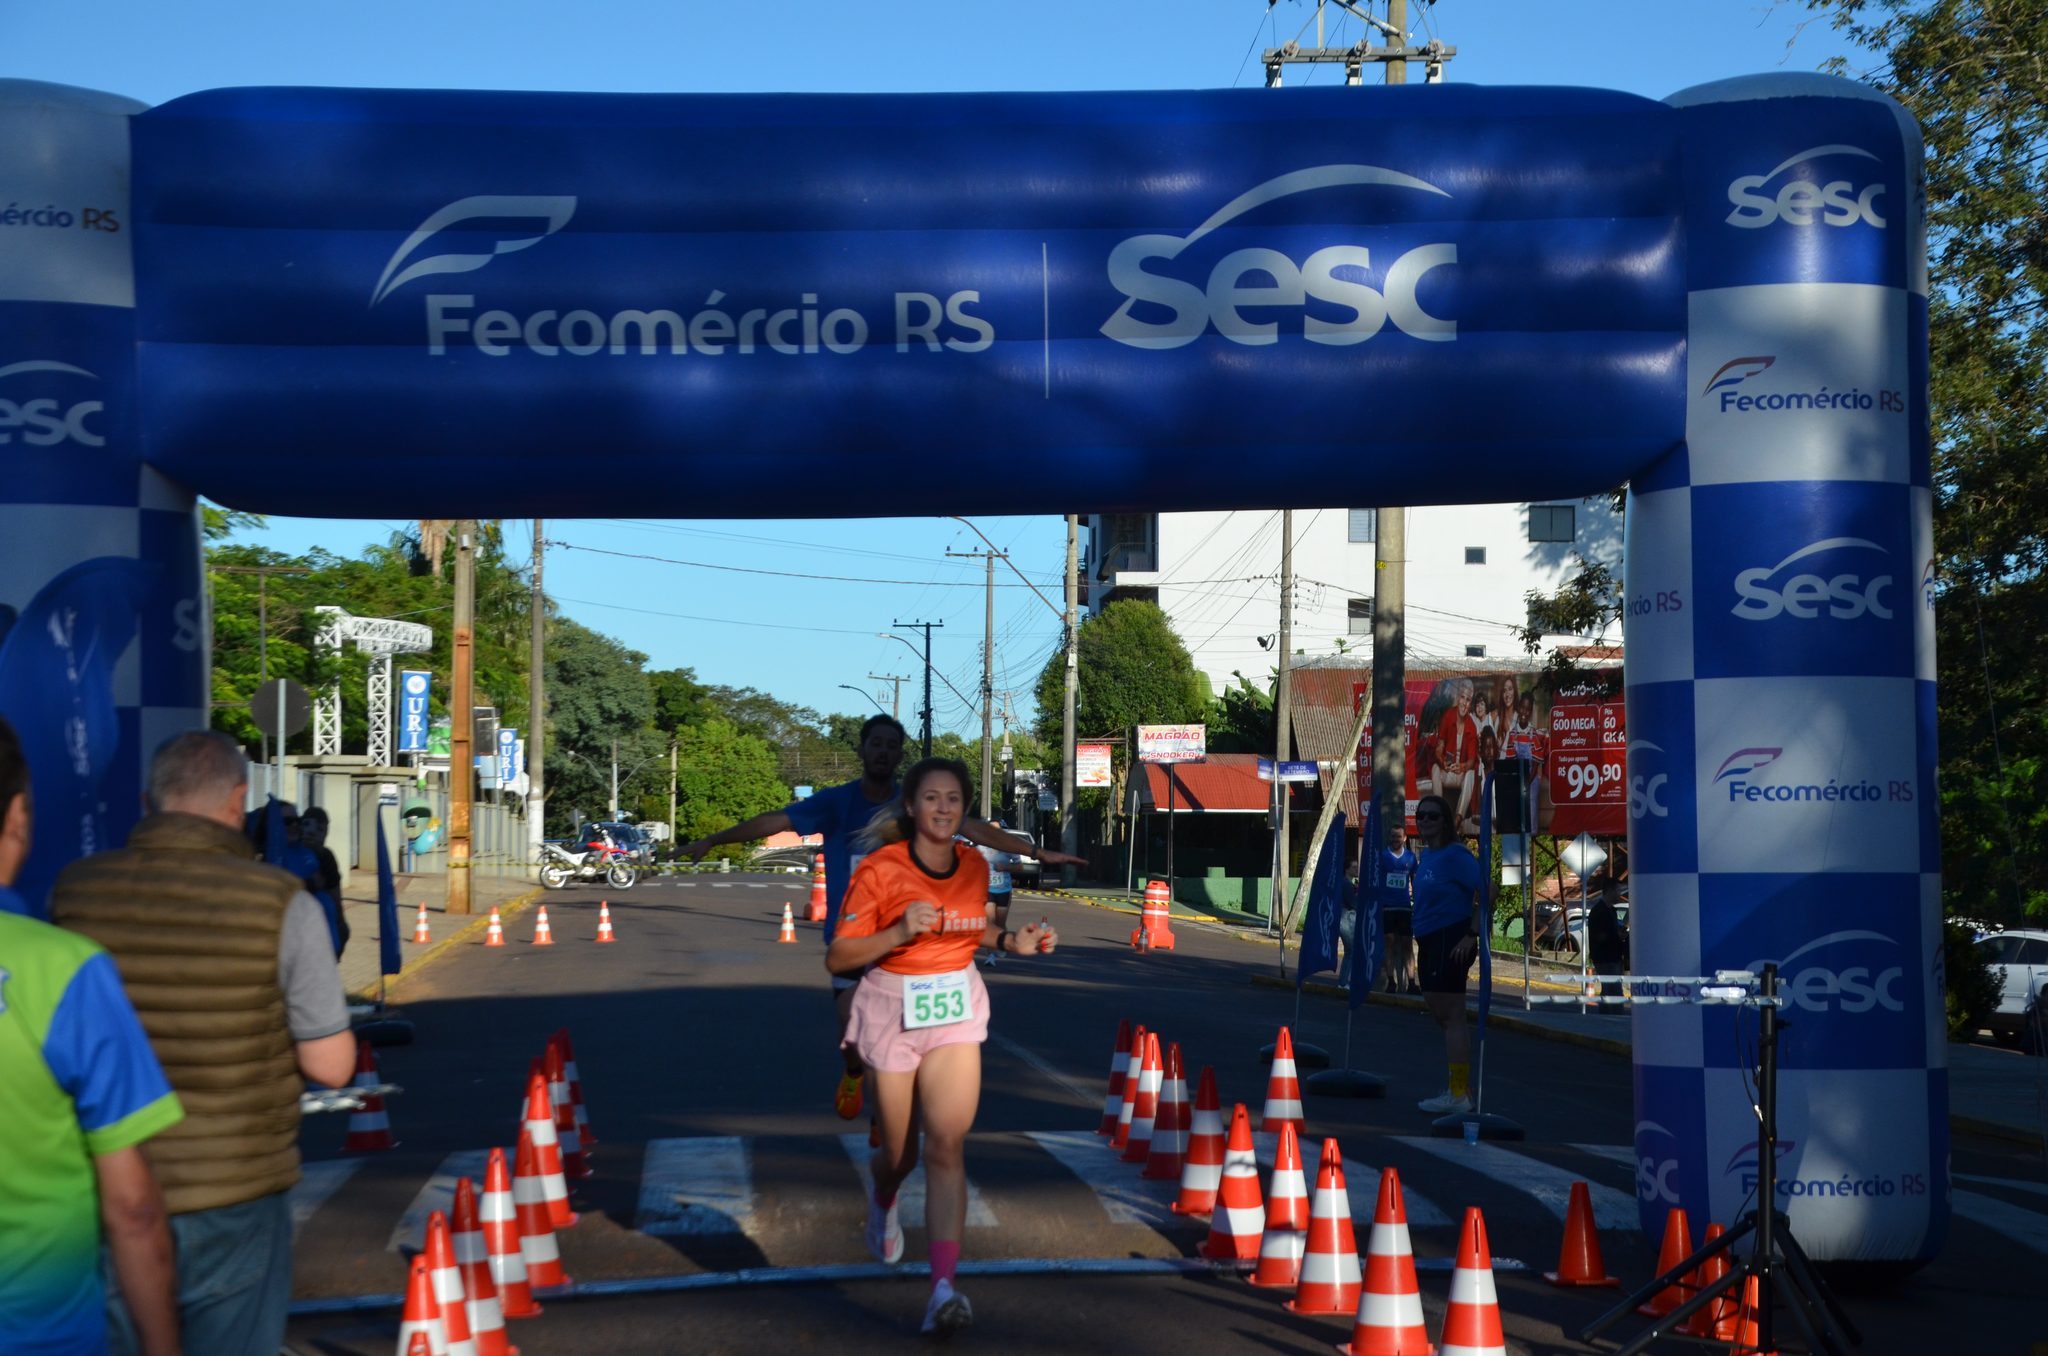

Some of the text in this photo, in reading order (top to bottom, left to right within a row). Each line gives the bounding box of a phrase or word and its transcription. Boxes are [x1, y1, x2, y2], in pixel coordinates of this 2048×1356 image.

[1725, 174, 1887, 229] Sesc
[0, 203, 120, 232] ércio RS
[1100, 234, 1457, 350] Sesc
[425, 289, 995, 356] Fecomércio RS
[1720, 387, 1904, 413] Fecomércio RS
[1656, 590, 1682, 613] RS
[1731, 566, 1893, 621] Sesc
[407, 697, 424, 749] URI
[1553, 717, 1596, 731] 600 MEGA
[1604, 716, 1617, 729] 60
[500, 745, 513, 780] URI
[1150, 751, 1195, 759] SNOOKER
[1567, 763, 1622, 799] 99,90
[1730, 780, 1913, 802] Fecomércio RS
[915, 989, 964, 1021] 553
[1742, 1173, 1925, 1197] Fcomércio RS
